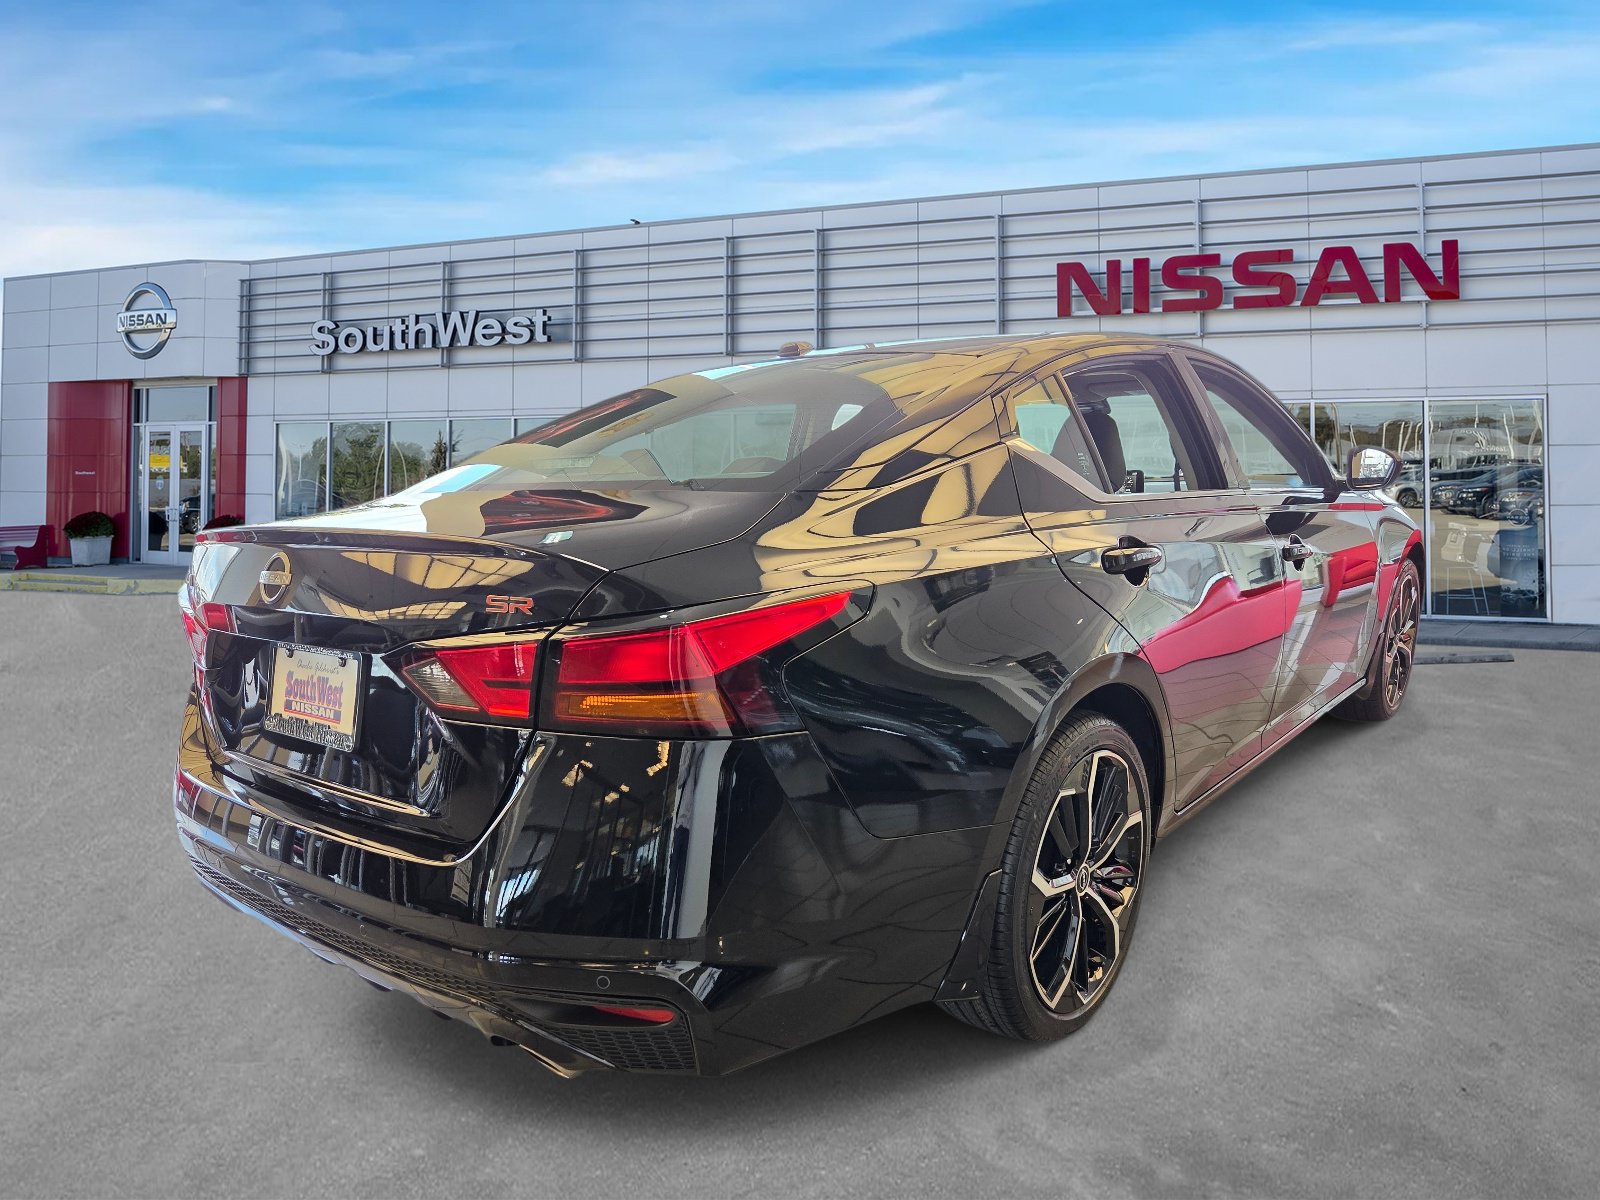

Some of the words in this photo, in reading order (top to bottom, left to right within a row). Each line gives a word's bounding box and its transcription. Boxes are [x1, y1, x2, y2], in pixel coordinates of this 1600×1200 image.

[1056, 239, 1460, 318] NISSAN
[119, 312, 167, 328] NISSAN
[308, 308, 551, 356] SouthWest
[485, 594, 534, 615] SR
[284, 670, 344, 709] SouthWest
[291, 700, 335, 719] NISSAN
